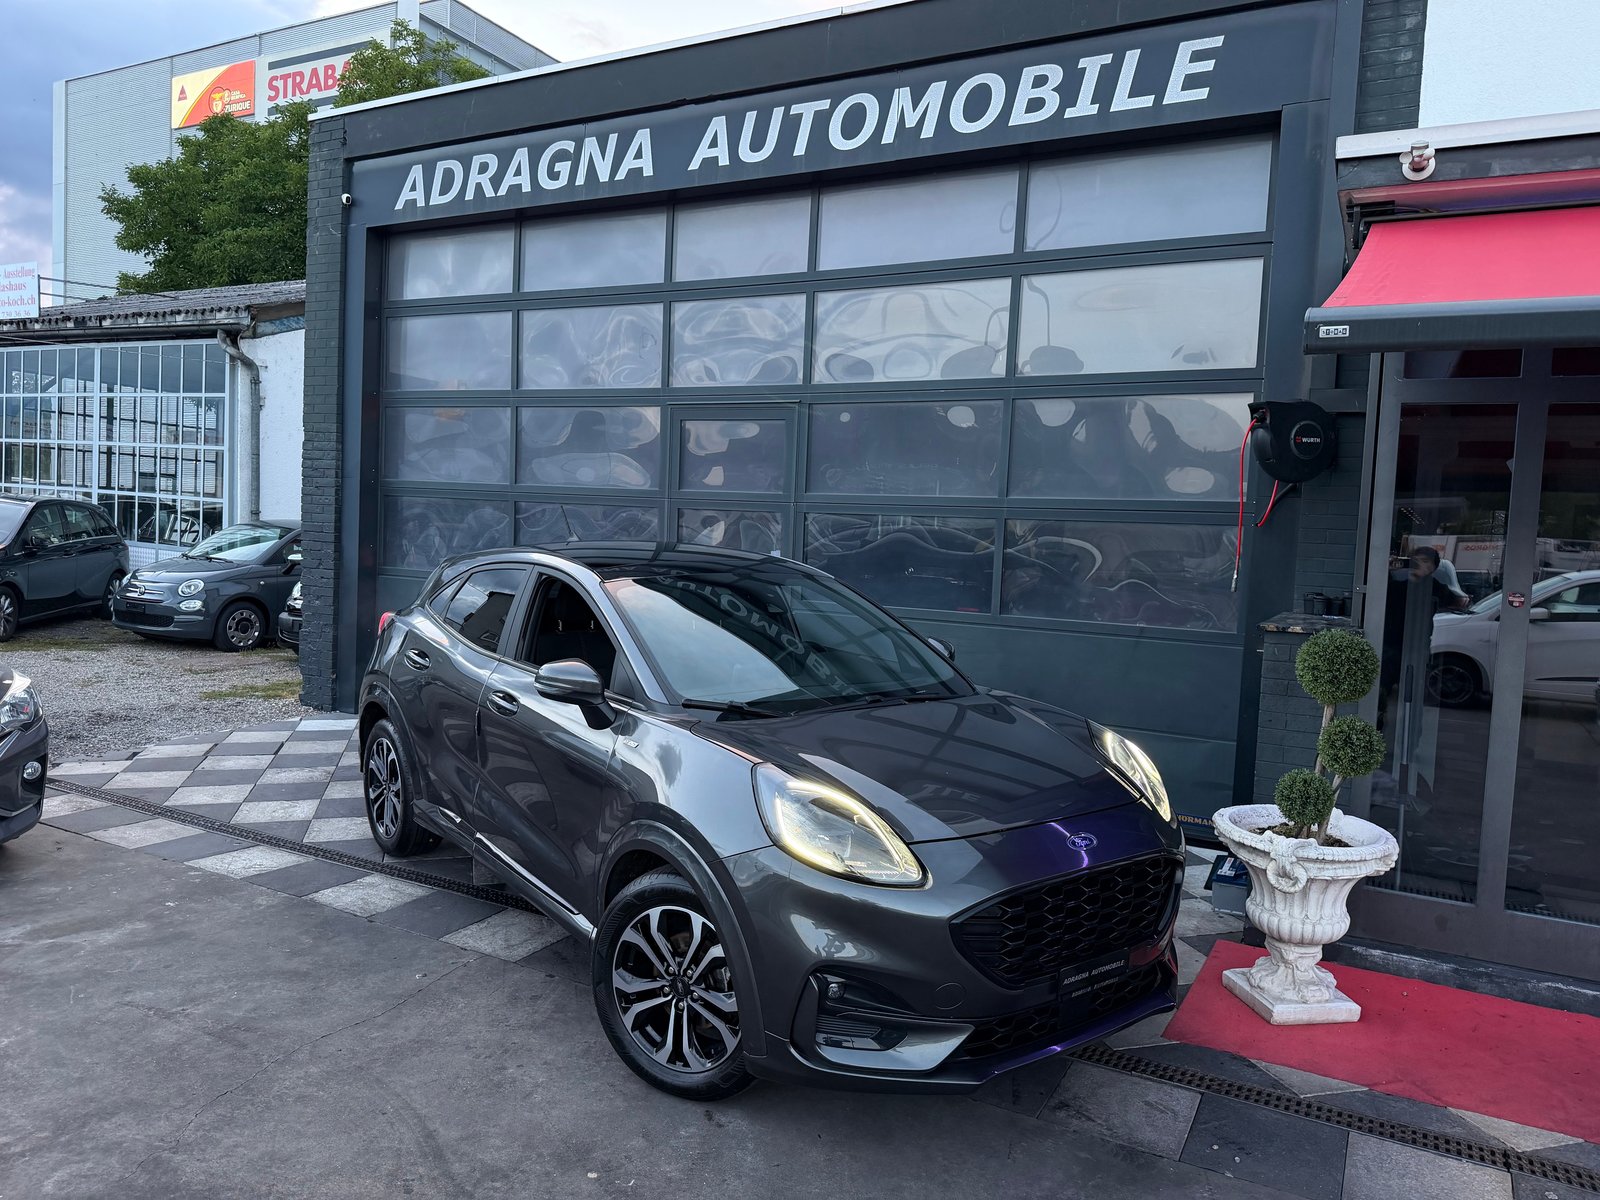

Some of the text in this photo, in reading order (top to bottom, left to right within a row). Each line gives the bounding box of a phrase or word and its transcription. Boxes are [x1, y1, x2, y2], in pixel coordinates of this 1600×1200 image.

[224, 100, 251, 113] ZURIQUE
[394, 35, 1225, 211] ADRAGNA AUTOMOBILE
[1091, 959, 1125, 976] AUTOMOBILE
